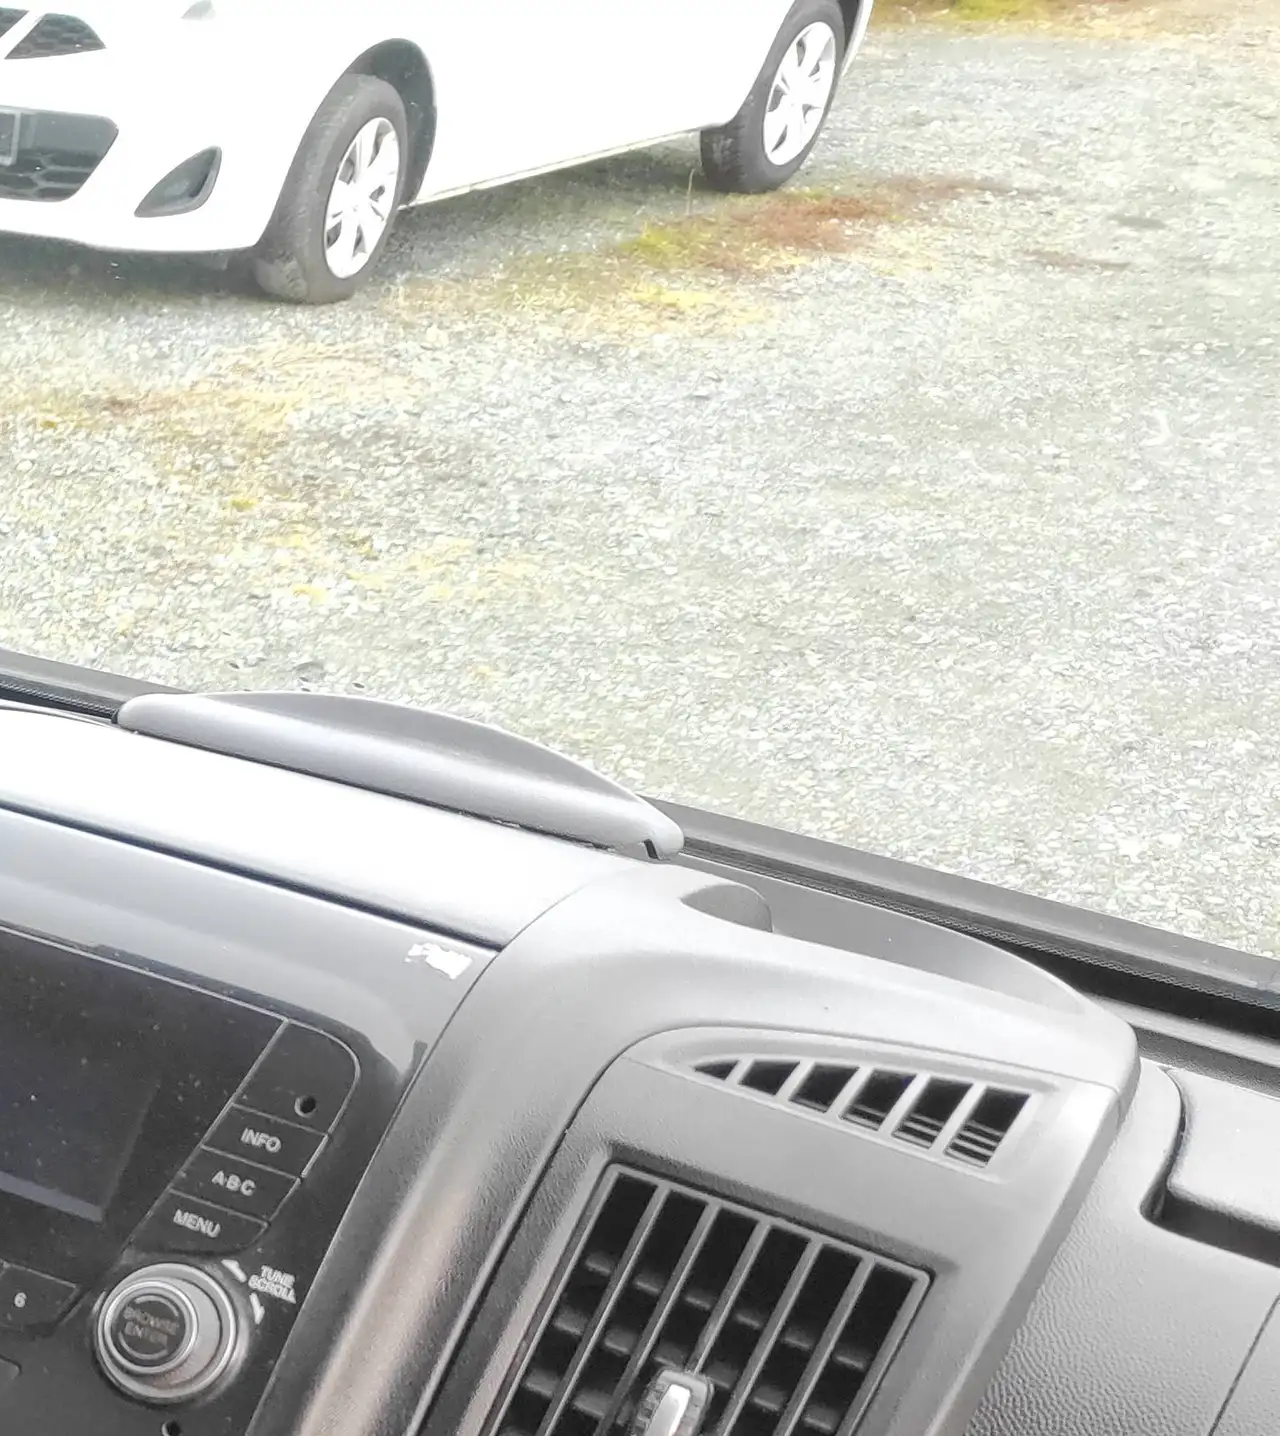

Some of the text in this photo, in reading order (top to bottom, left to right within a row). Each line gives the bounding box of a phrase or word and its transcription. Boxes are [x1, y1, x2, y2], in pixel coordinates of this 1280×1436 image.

[240, 1127, 282, 1153] INFO
[211, 1170, 256, 1196] ABC
[173, 1208, 221, 1238] MENU
[248, 1275, 297, 1304] SCROLL
[261, 1265, 295, 1288] TUNE
[13, 1292, 28, 1308] 6
